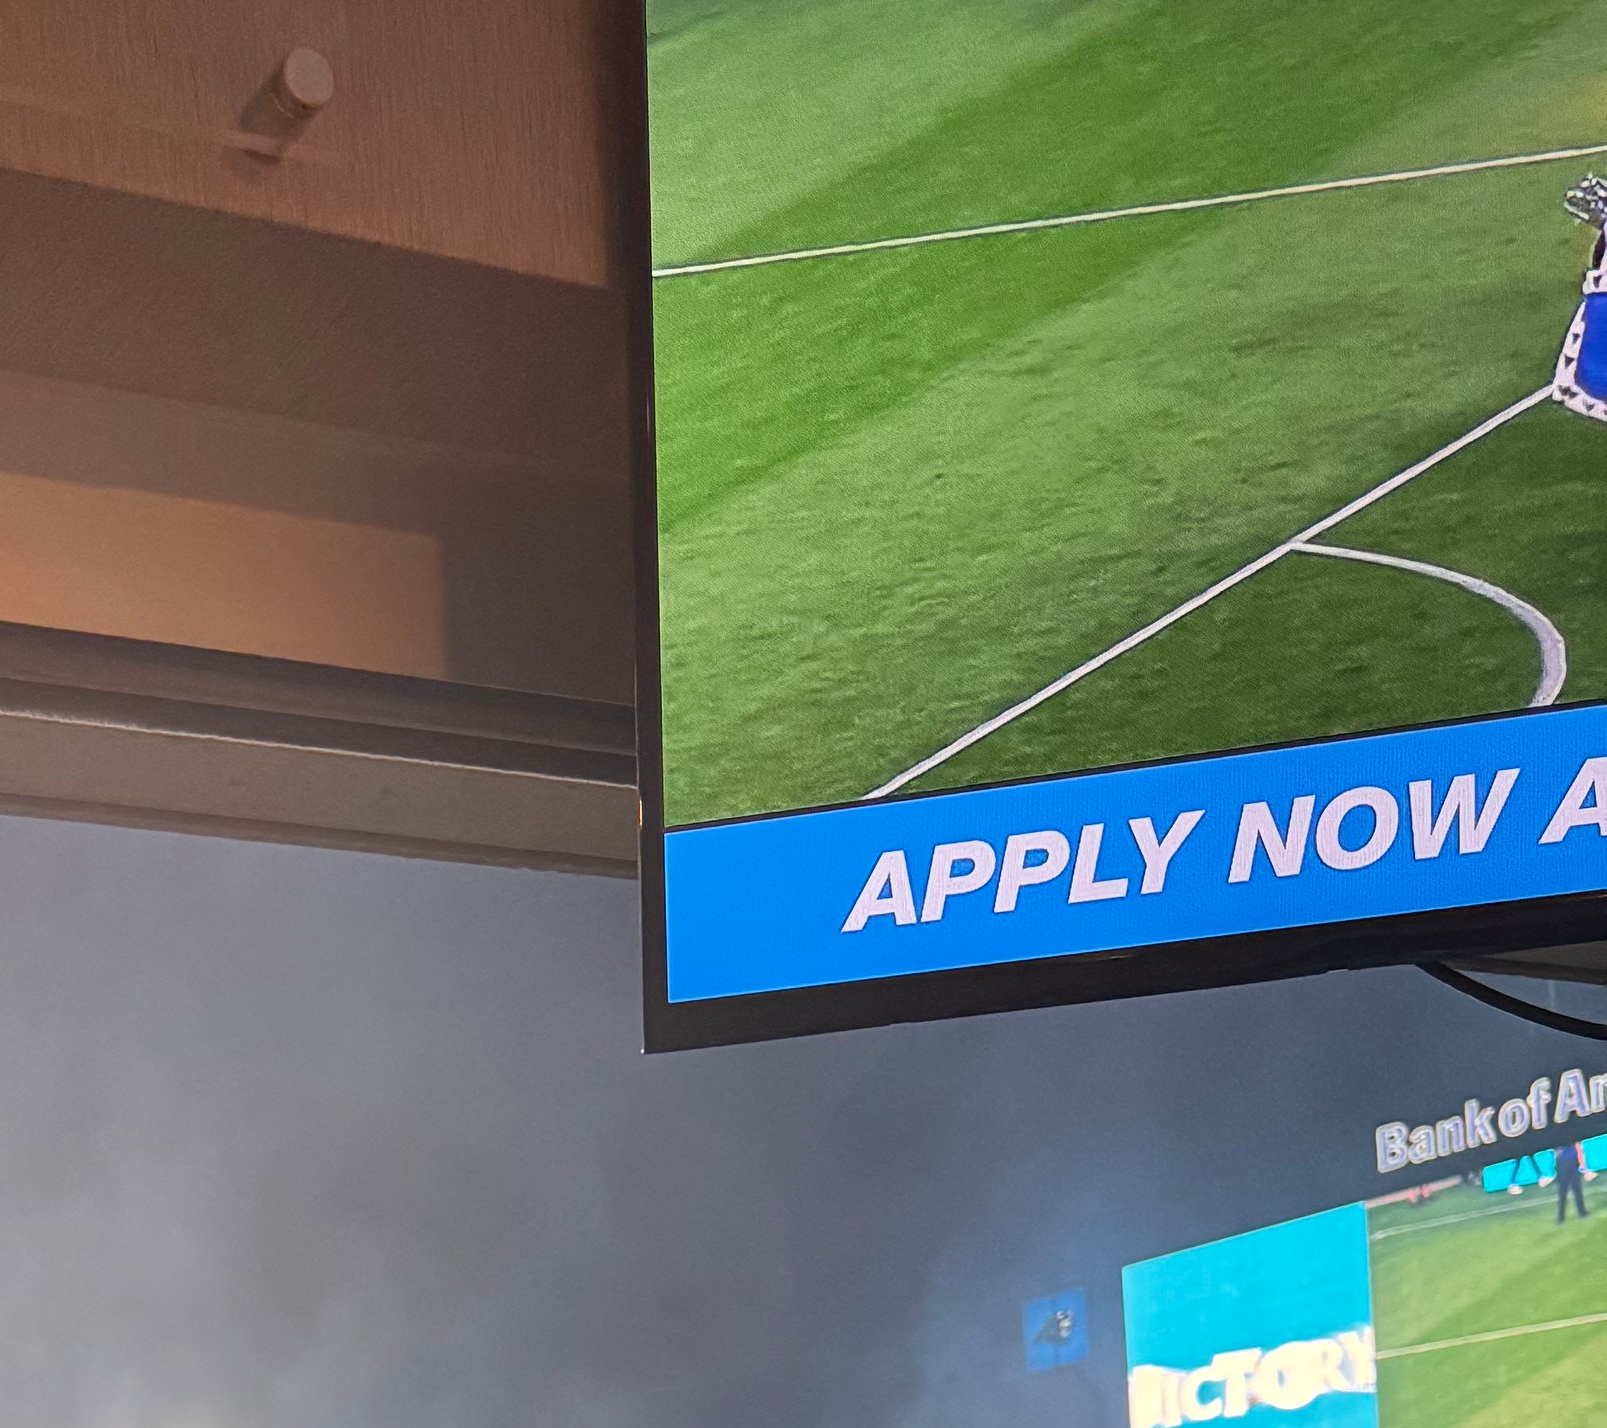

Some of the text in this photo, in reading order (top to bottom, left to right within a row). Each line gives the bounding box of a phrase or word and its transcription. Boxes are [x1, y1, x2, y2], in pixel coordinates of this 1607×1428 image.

[840, 809, 1205, 934] APPLY
[1227, 768, 1520, 884] NOW
[1375, 1098, 1497, 1174] Bank
[1498, 1077, 1552, 1137] of
